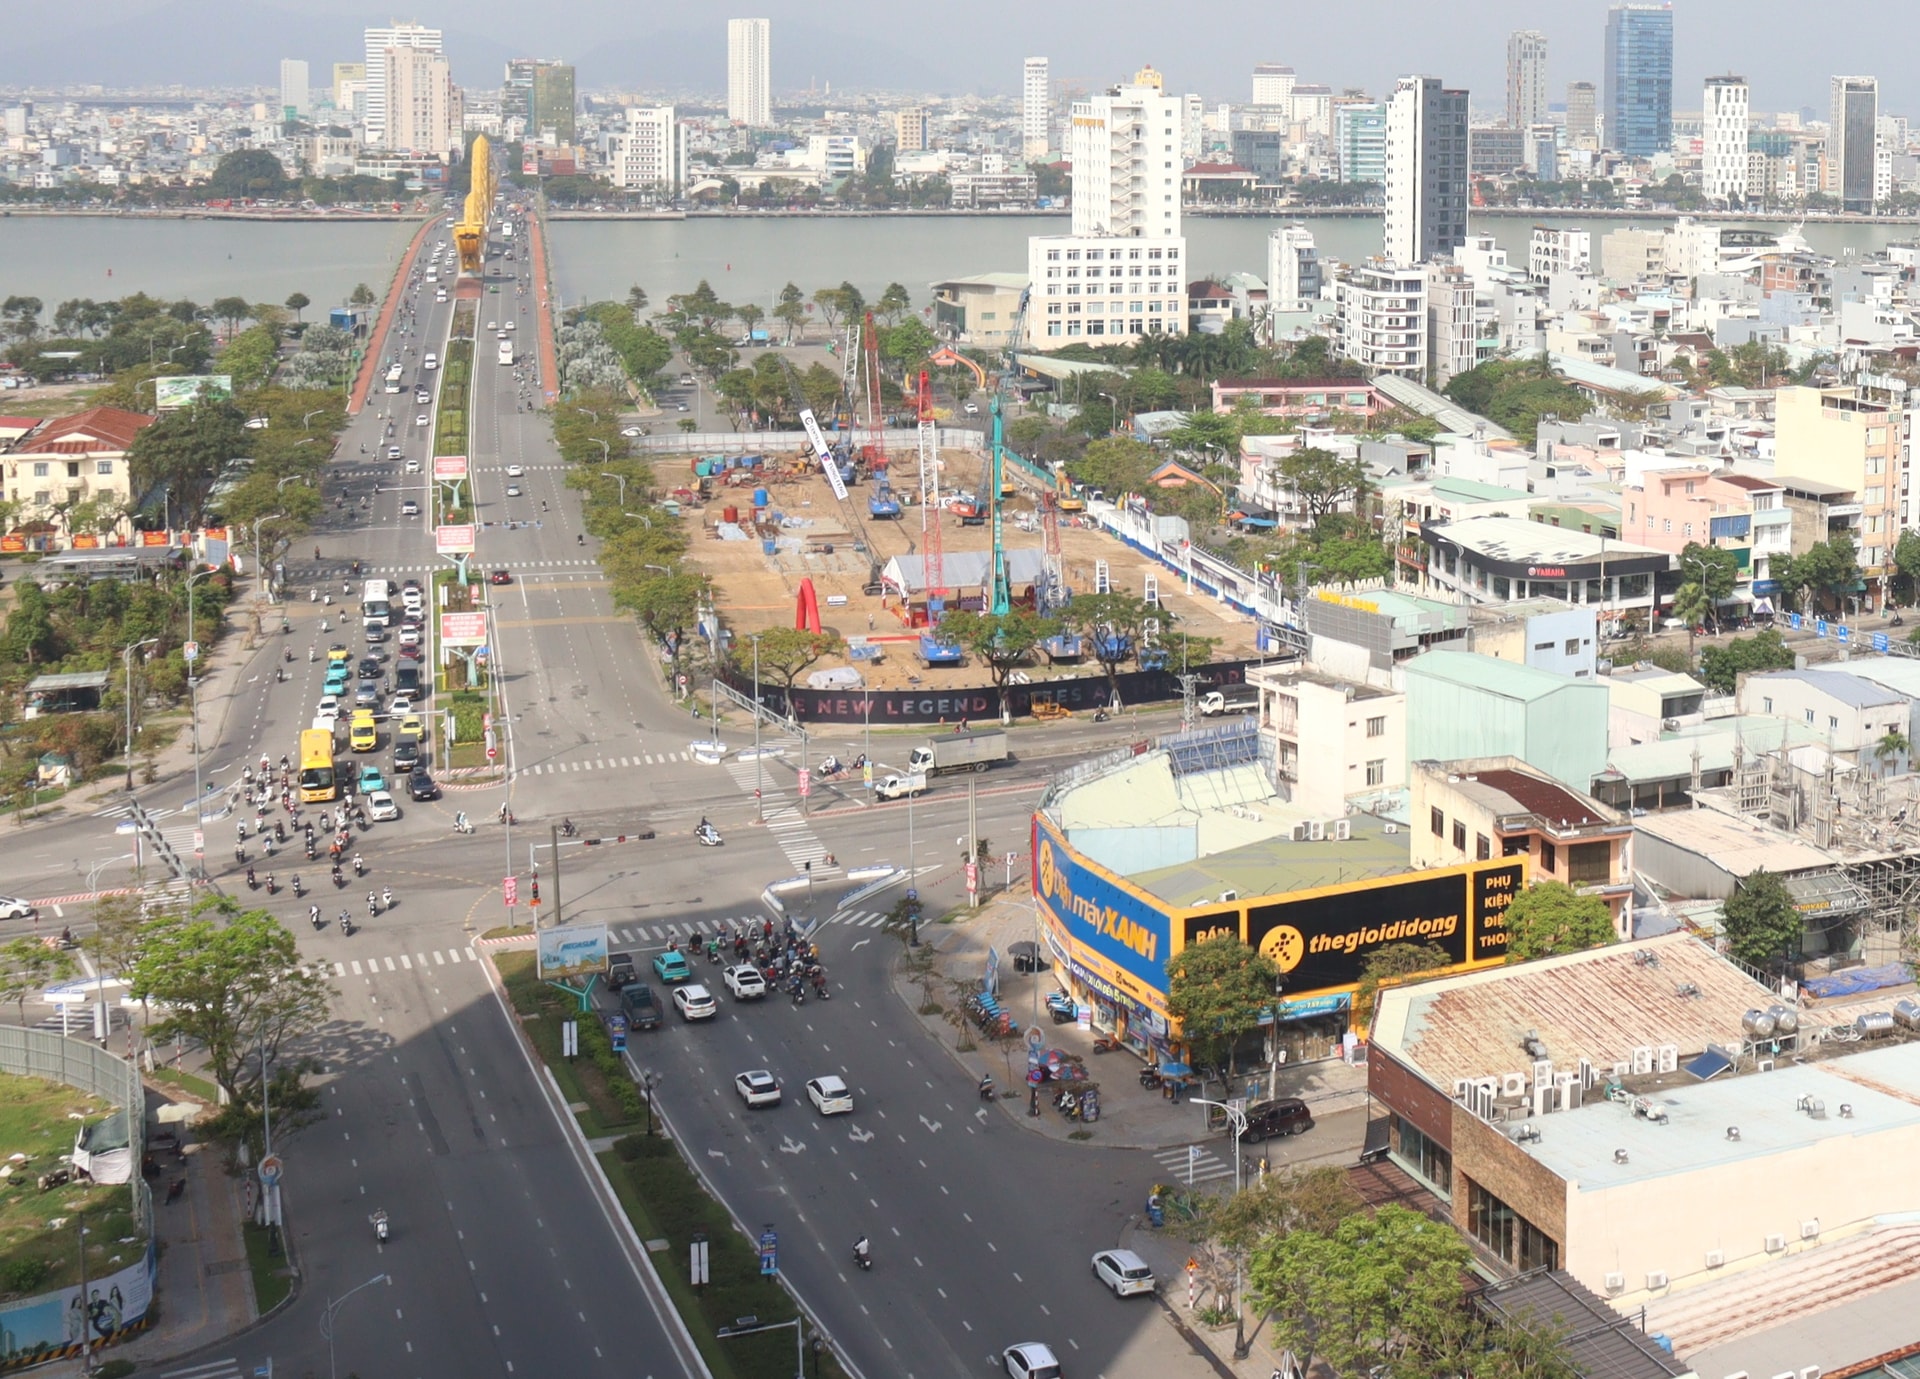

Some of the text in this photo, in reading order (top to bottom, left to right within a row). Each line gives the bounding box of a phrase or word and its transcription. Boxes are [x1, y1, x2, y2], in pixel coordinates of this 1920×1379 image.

[1536, 567, 1566, 577] YAMAHA
[768, 694, 805, 713] THE
[817, 699, 873, 715] NEW
[886, 698, 988, 716] LEGEND
[1485, 874, 1512, 891] PHỤ
[1484, 893, 1513, 910] KIỆN
[1484, 912, 1506, 929] ĐIỆ
[1102, 905, 1158, 962] XANH
[1309, 914, 1458, 954] thegioididong
[1479, 931, 1511, 948] THO
[1113, 989, 1120, 1003] 5
